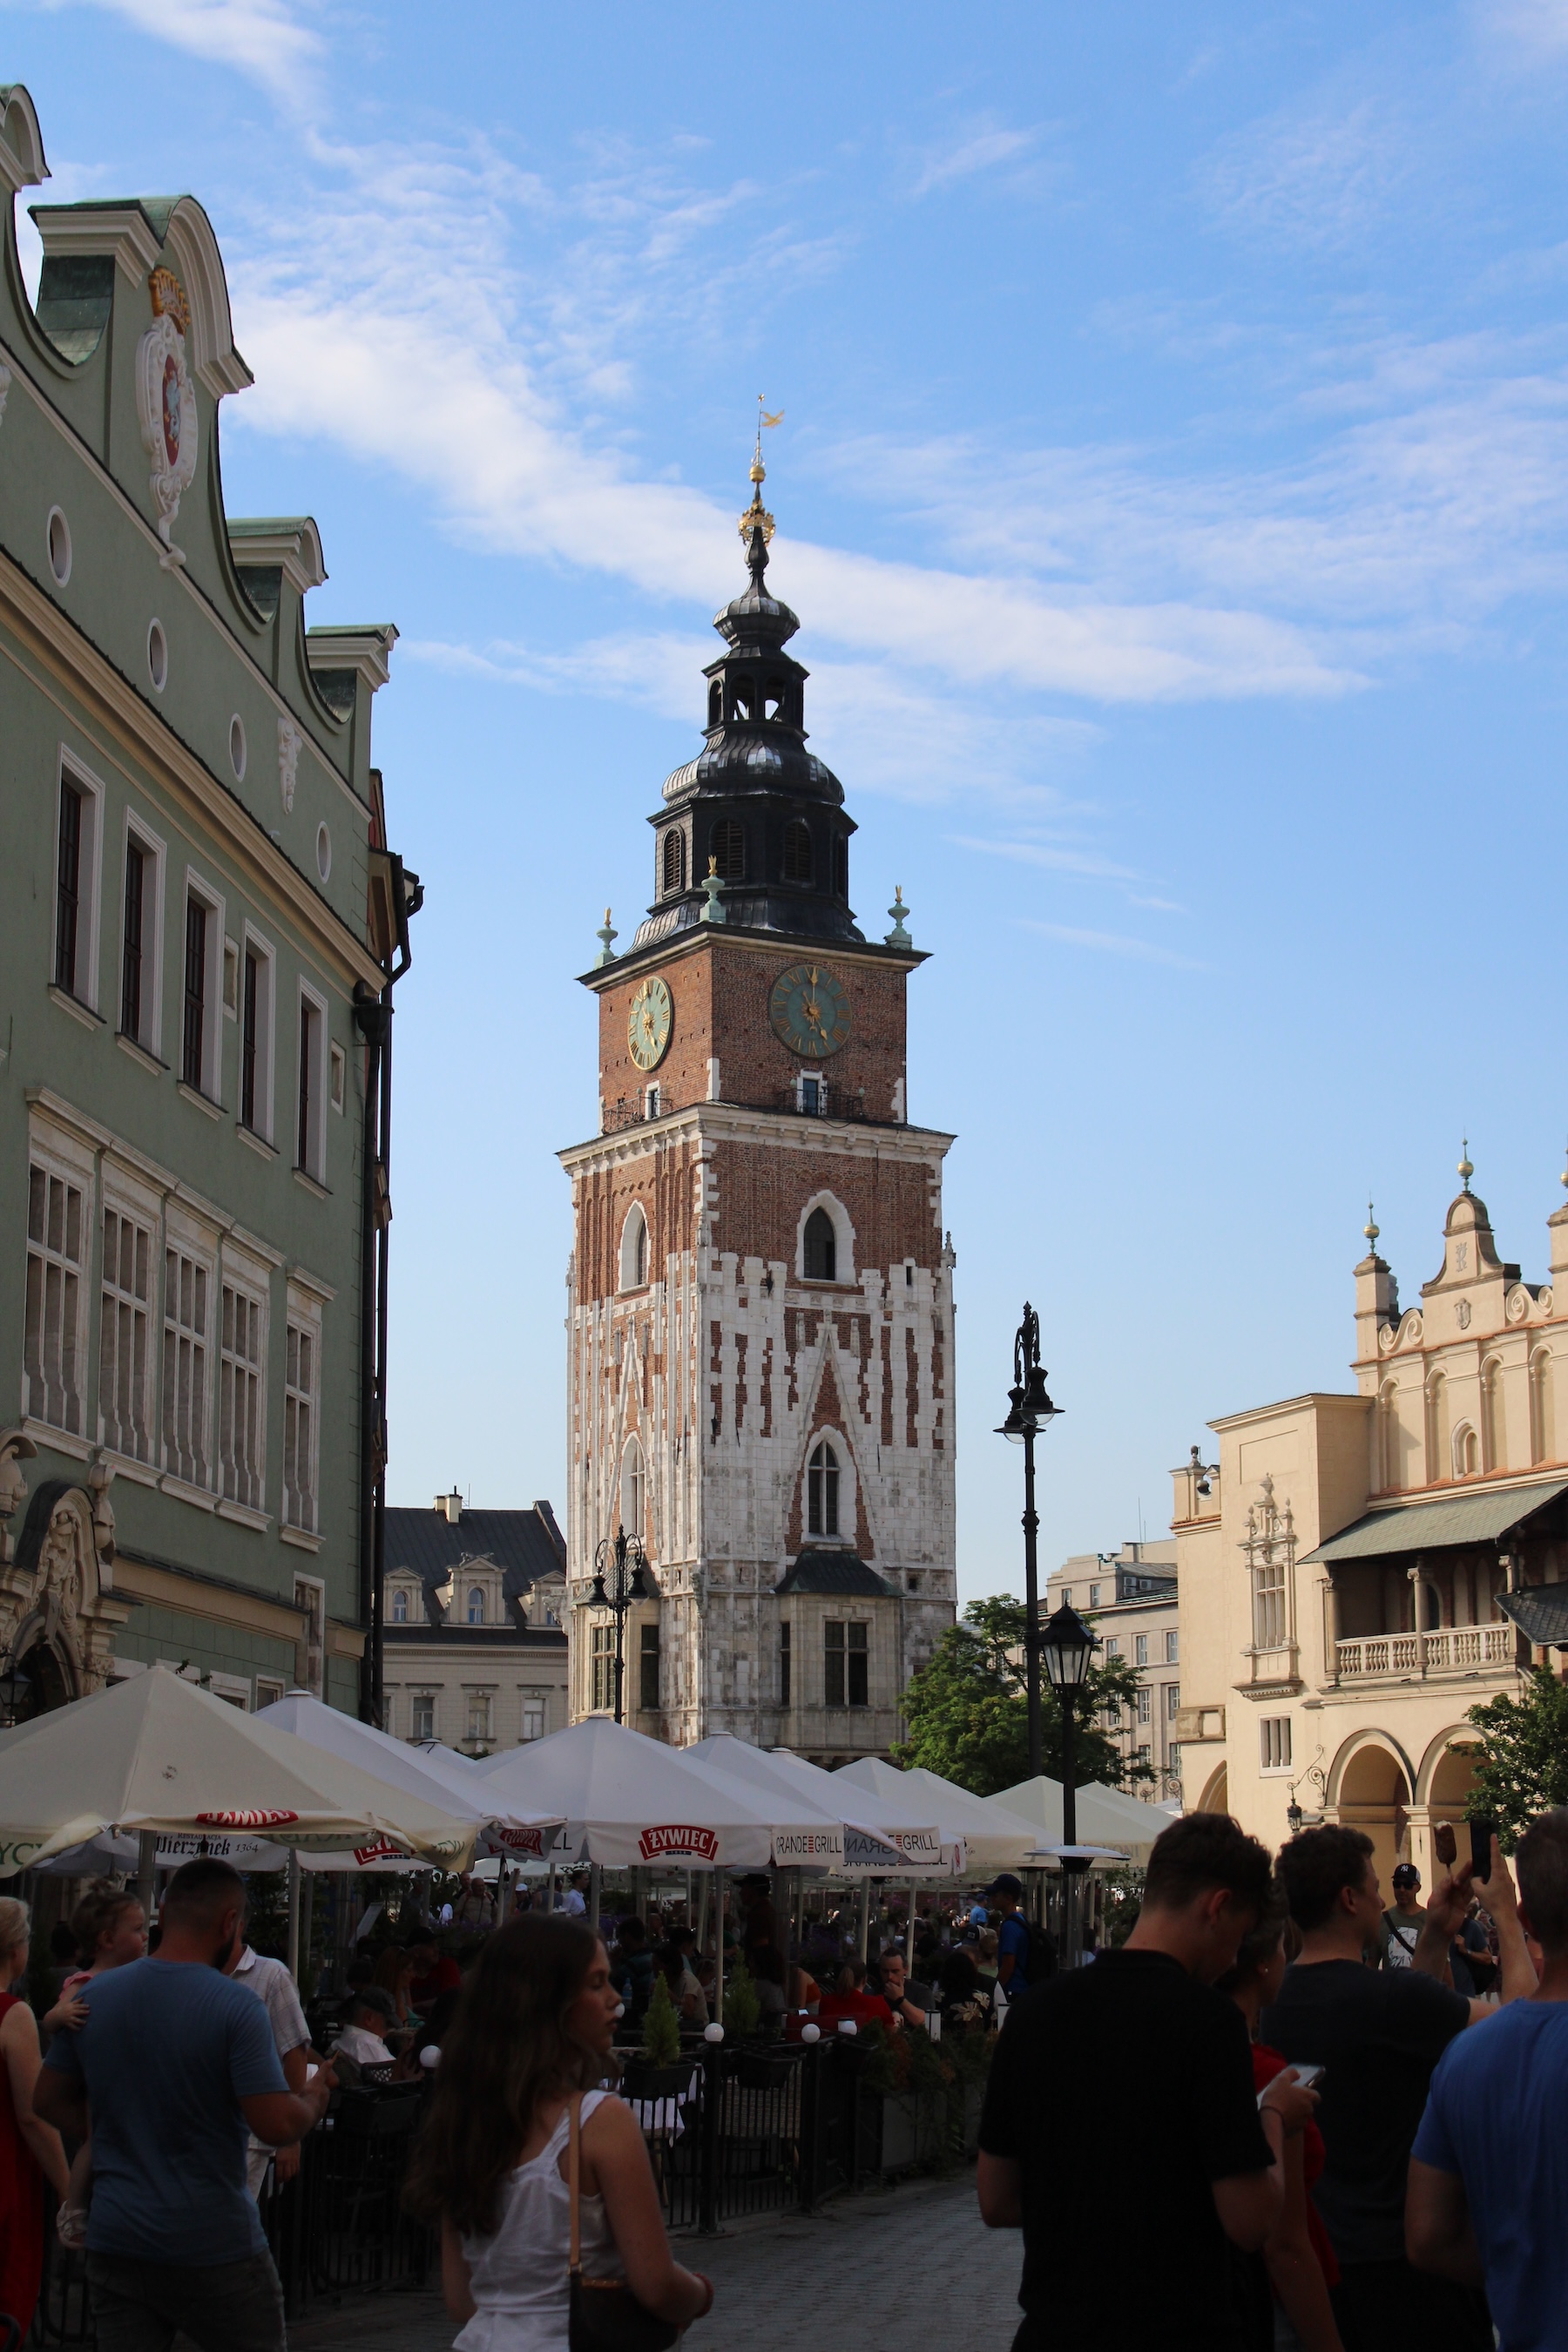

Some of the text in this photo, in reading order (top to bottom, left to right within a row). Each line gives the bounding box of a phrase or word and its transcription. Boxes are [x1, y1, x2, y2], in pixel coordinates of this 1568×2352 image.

[648, 1828, 710, 1849] ŻYWIEC
[776, 1835, 841, 1854] GRANDE GRILL
[902, 1835, 938, 1850] GRILL
[235, 1842, 259, 1854] 1364
